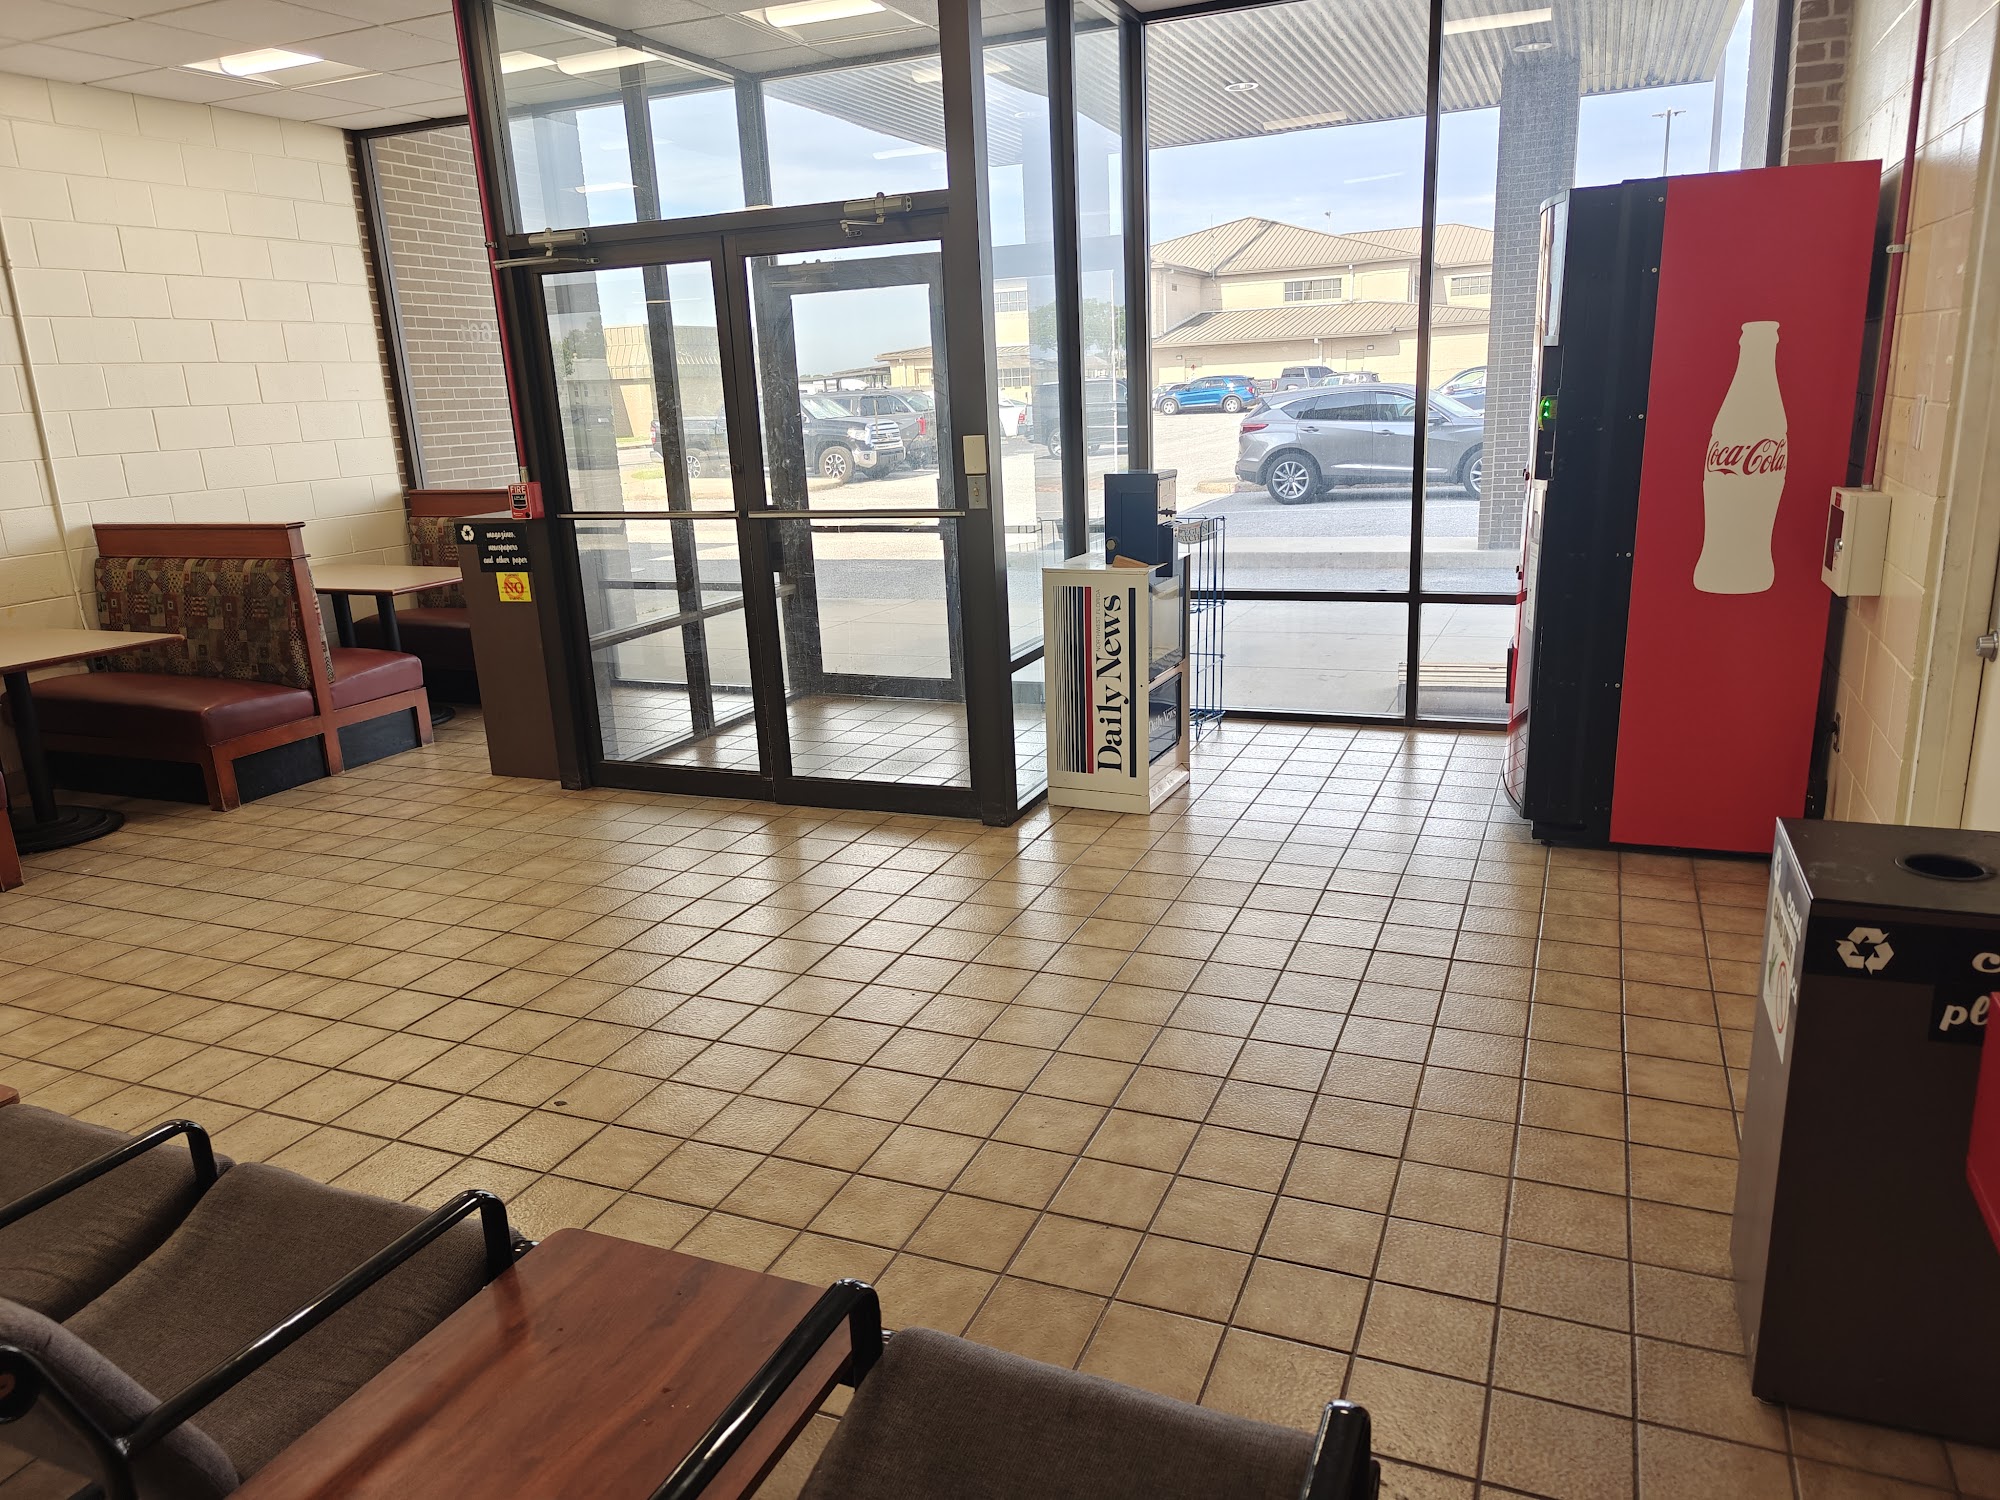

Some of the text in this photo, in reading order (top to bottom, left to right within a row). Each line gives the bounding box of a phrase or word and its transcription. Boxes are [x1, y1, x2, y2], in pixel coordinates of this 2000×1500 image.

[1707, 438, 1786, 476] Coca-Cola
[510, 485, 526, 494] FIRE
[488, 544, 518, 553] newspapers
[483, 555, 528, 565] and other paper
[504, 581, 525, 594] NO
[1096, 594, 1129, 775] Daily News
[1148, 708, 1177, 734] Daily News
[1971, 952, 2000, 973] c
[1939, 995, 1990, 1031] pl
